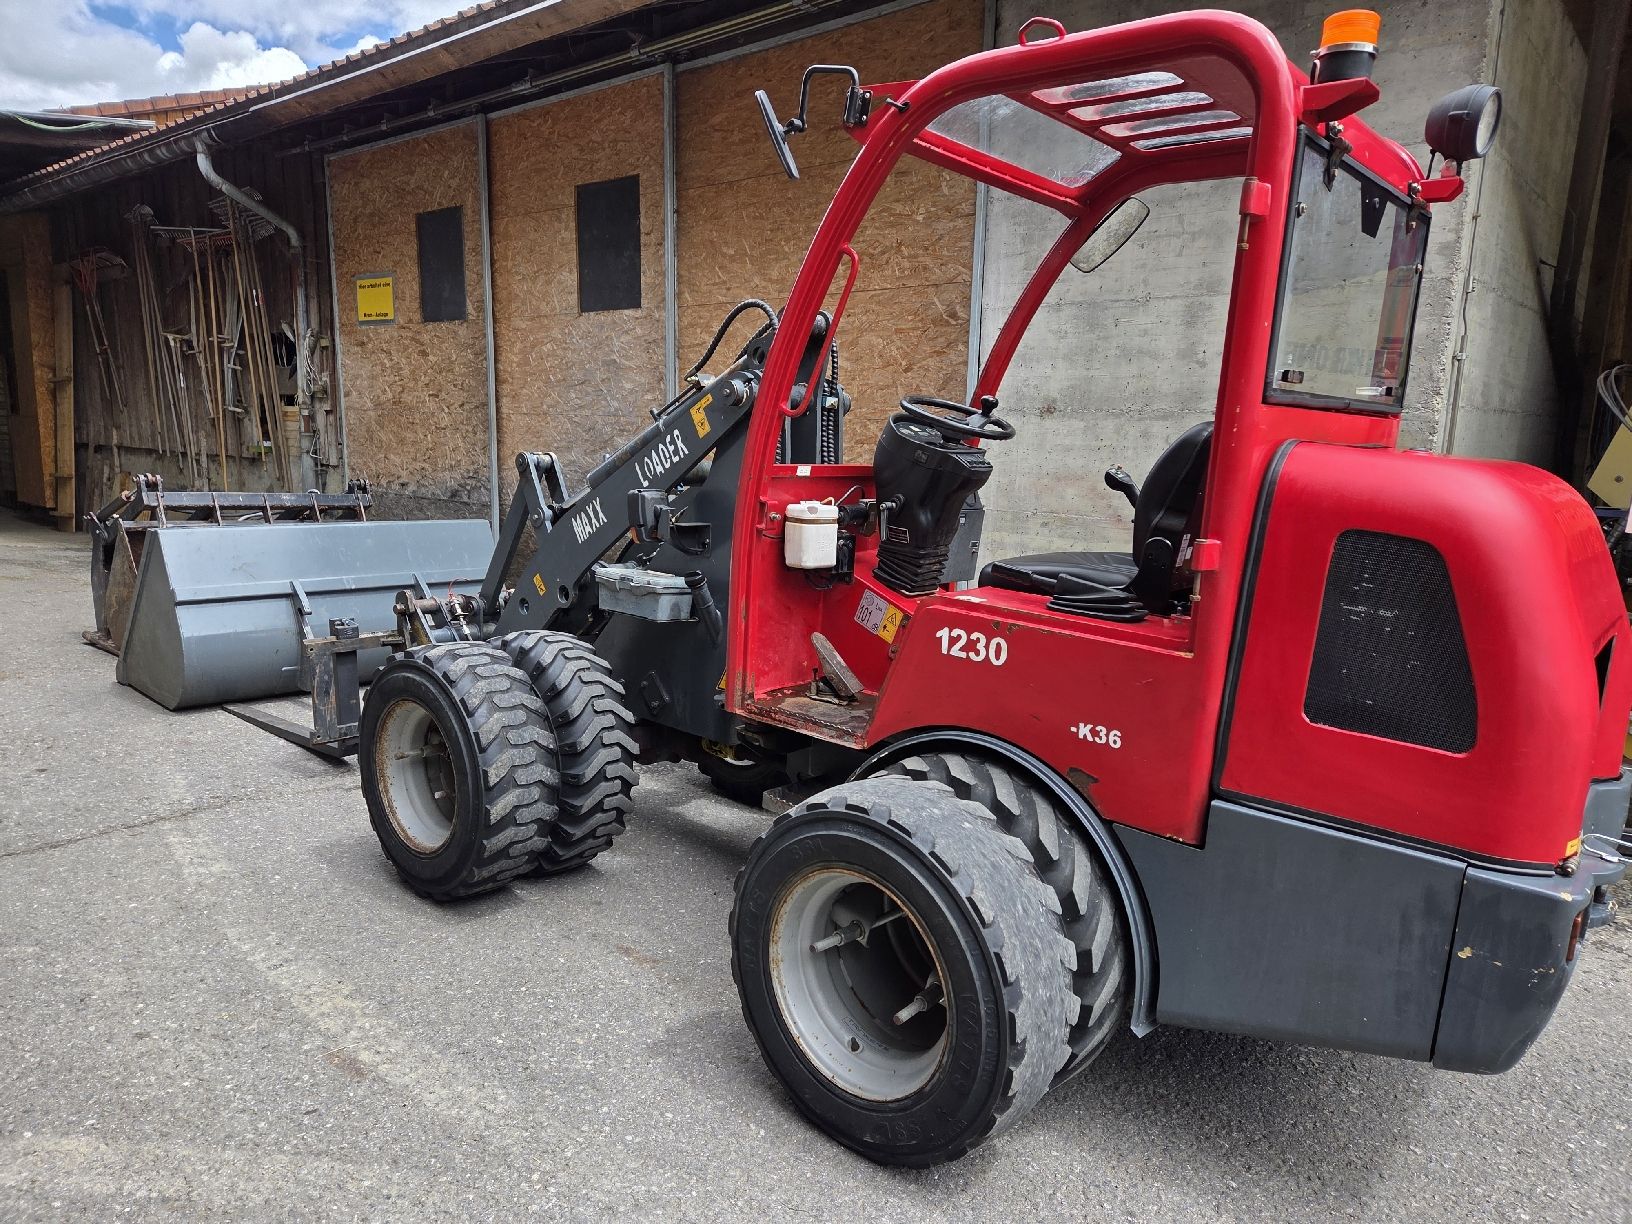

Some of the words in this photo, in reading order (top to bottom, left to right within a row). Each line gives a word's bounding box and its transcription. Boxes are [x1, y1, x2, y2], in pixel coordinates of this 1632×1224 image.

[571, 497, 608, 544] MAXX
[635, 428, 689, 488] LOADER
[858, 605, 872, 624] 101
[935, 626, 1008, 666] 1230
[1070, 722, 1122, 749] -K36
